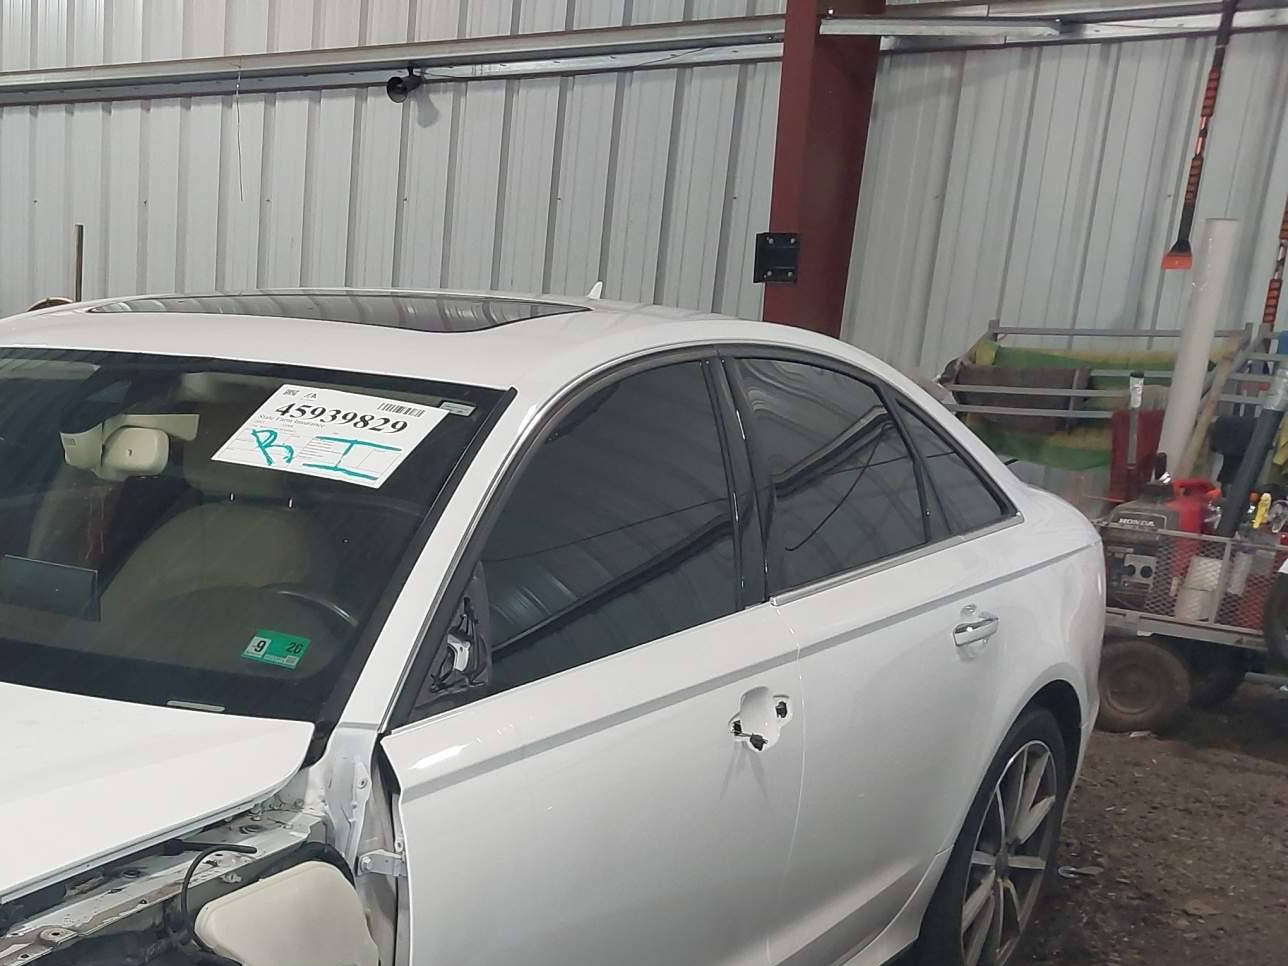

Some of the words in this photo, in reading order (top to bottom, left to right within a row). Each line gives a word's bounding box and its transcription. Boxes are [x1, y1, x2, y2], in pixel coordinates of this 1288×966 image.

[275, 402, 408, 434] 45939829
[1119, 518, 1154, 527] HONDA
[254, 640, 267, 652] 9
